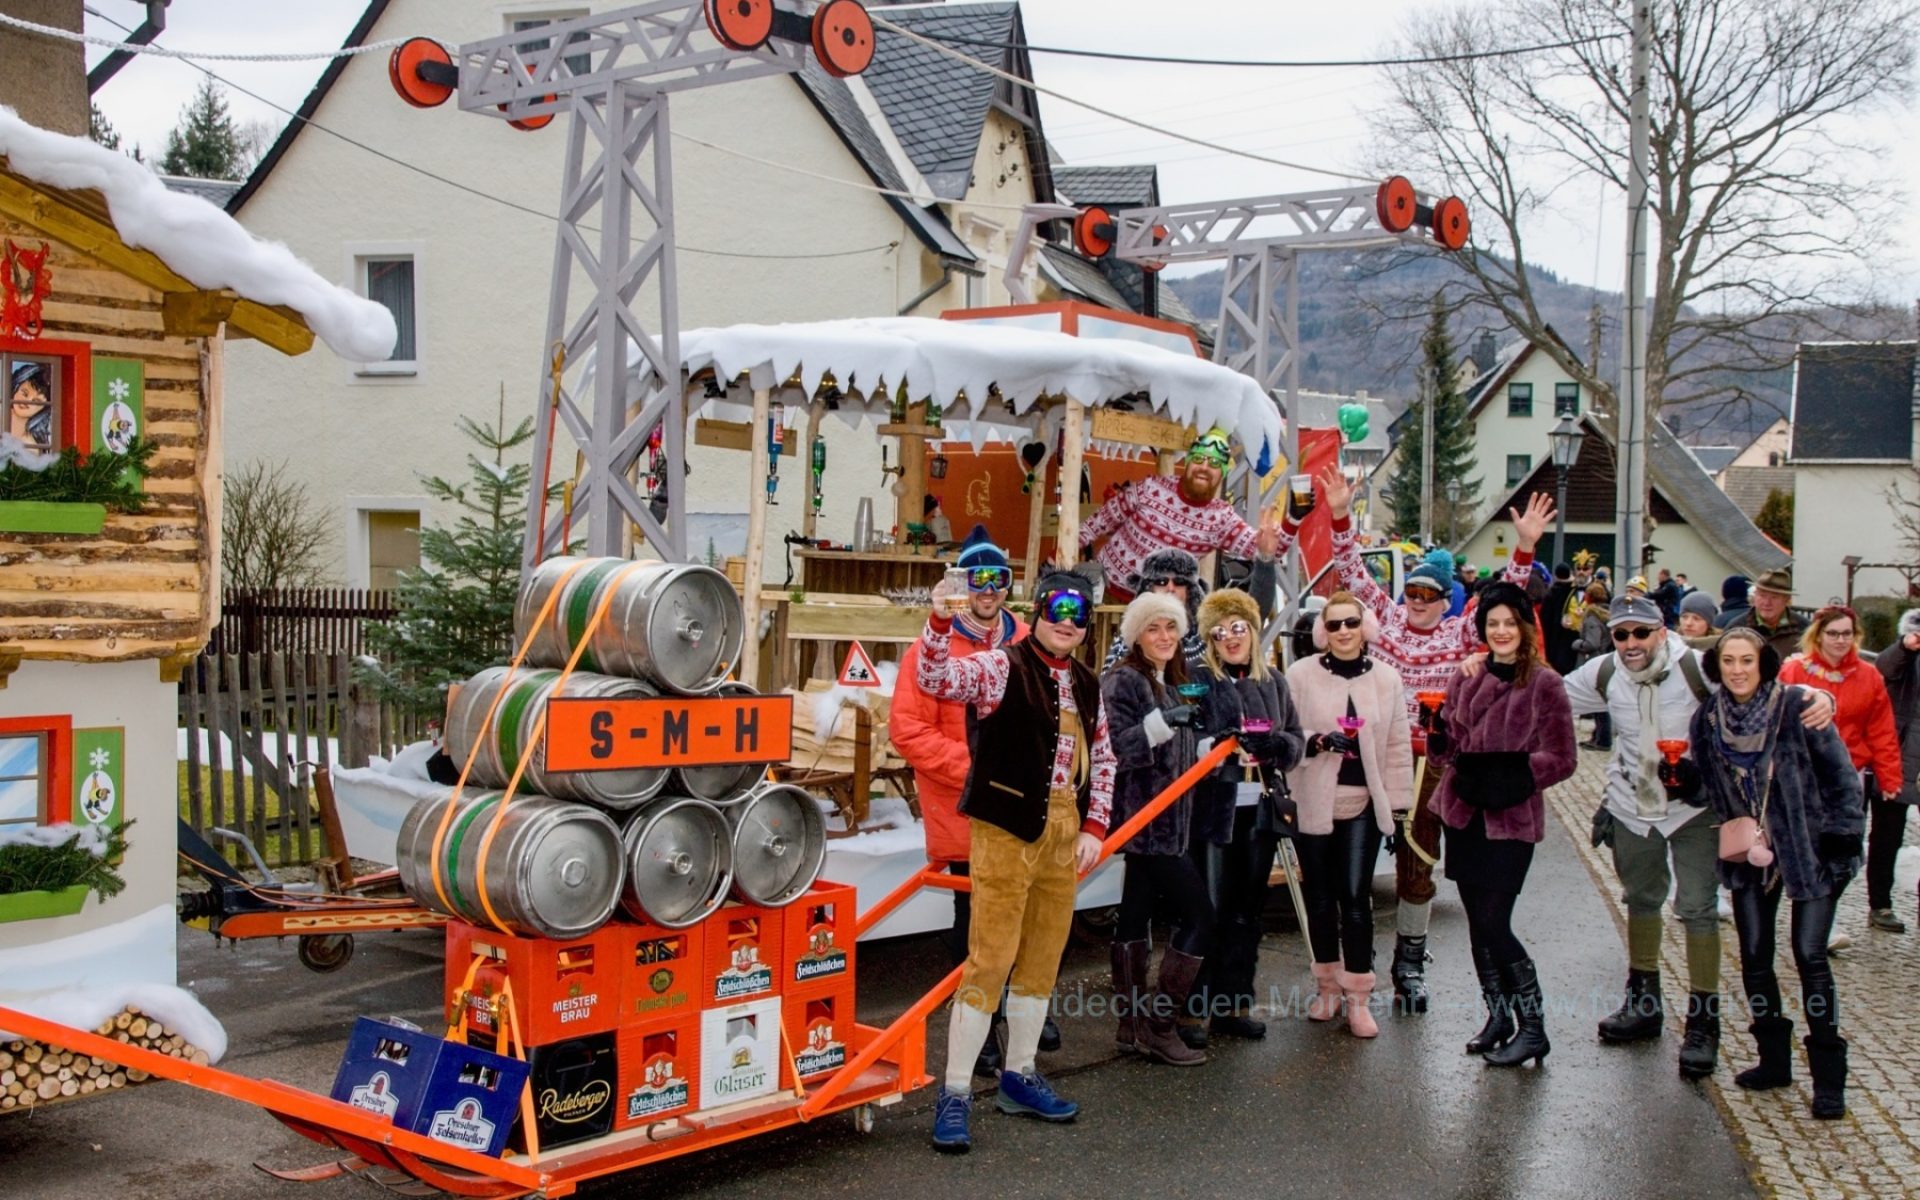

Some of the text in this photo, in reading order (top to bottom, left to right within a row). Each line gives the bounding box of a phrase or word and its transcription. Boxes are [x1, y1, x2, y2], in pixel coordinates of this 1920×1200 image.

[552, 993, 598, 1013] MEISTER
[538, 1087, 607, 1119] Radeberger
[435, 1123, 487, 1145] Felsenkeller
